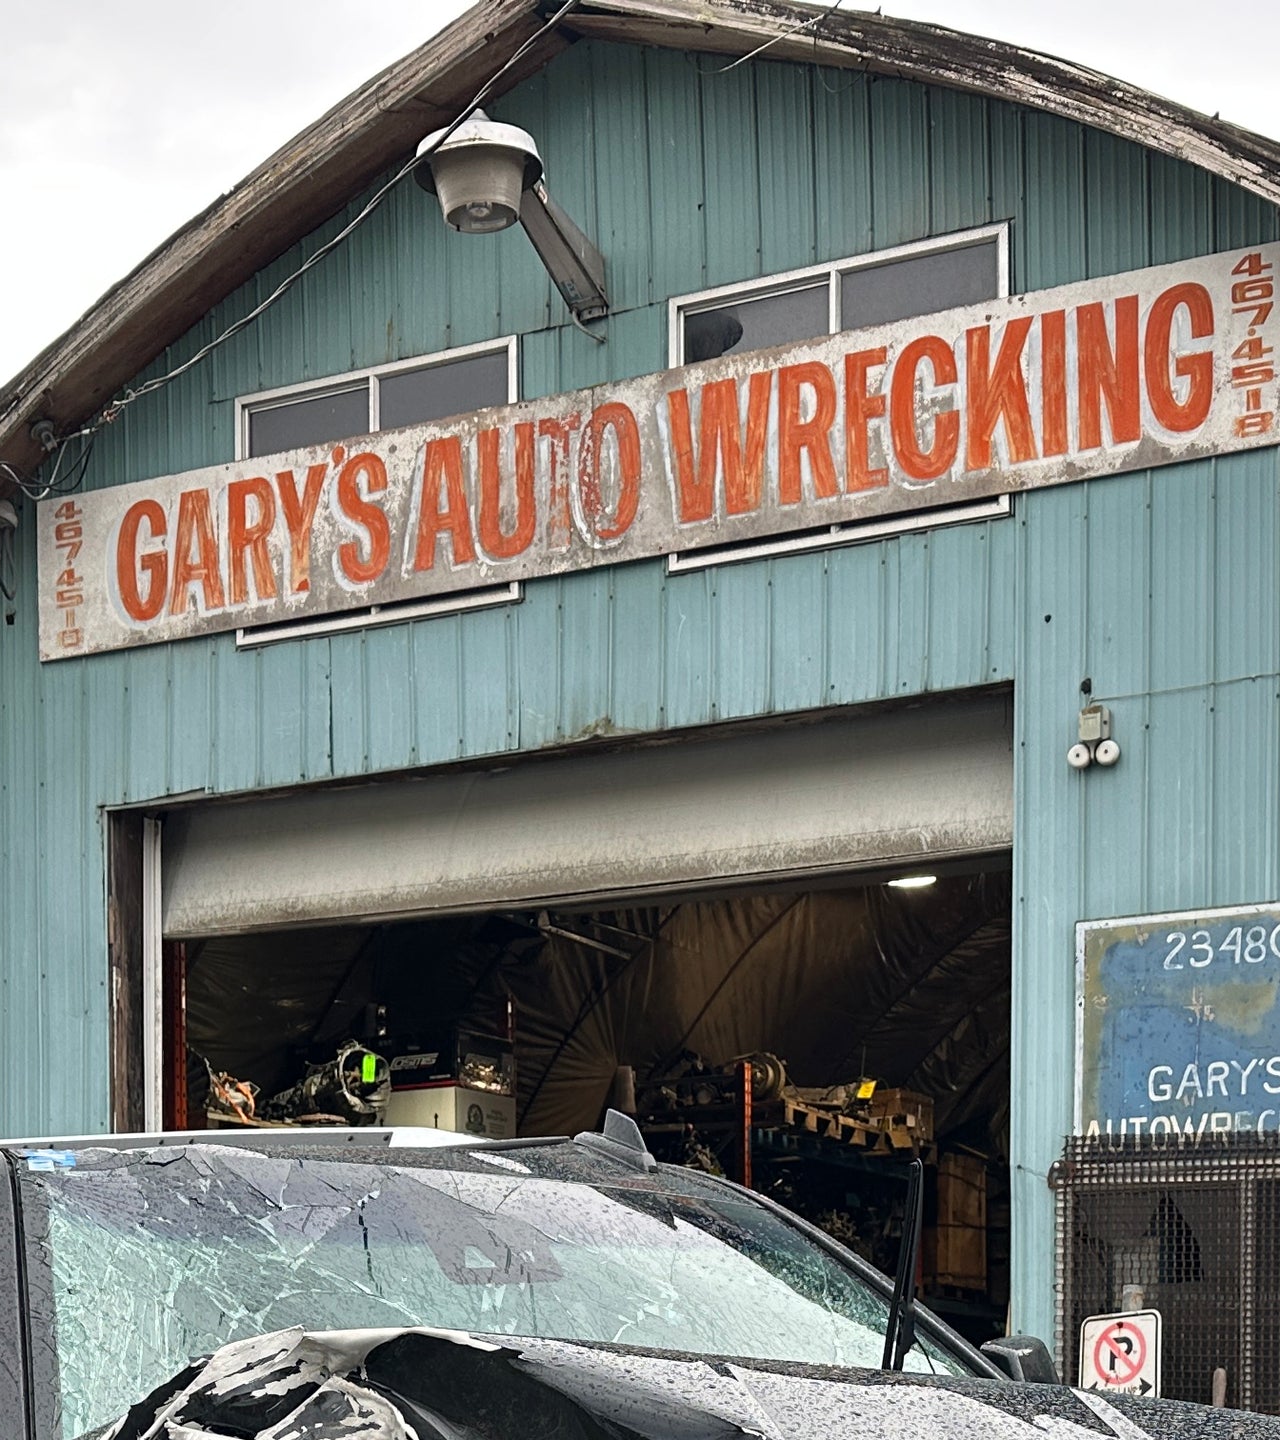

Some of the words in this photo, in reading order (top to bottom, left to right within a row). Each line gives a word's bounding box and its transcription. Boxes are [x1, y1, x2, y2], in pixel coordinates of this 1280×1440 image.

[116, 446, 390, 622] GARY'S
[414, 401, 642, 572] AUTO
[667, 282, 1215, 523] WRECKING
